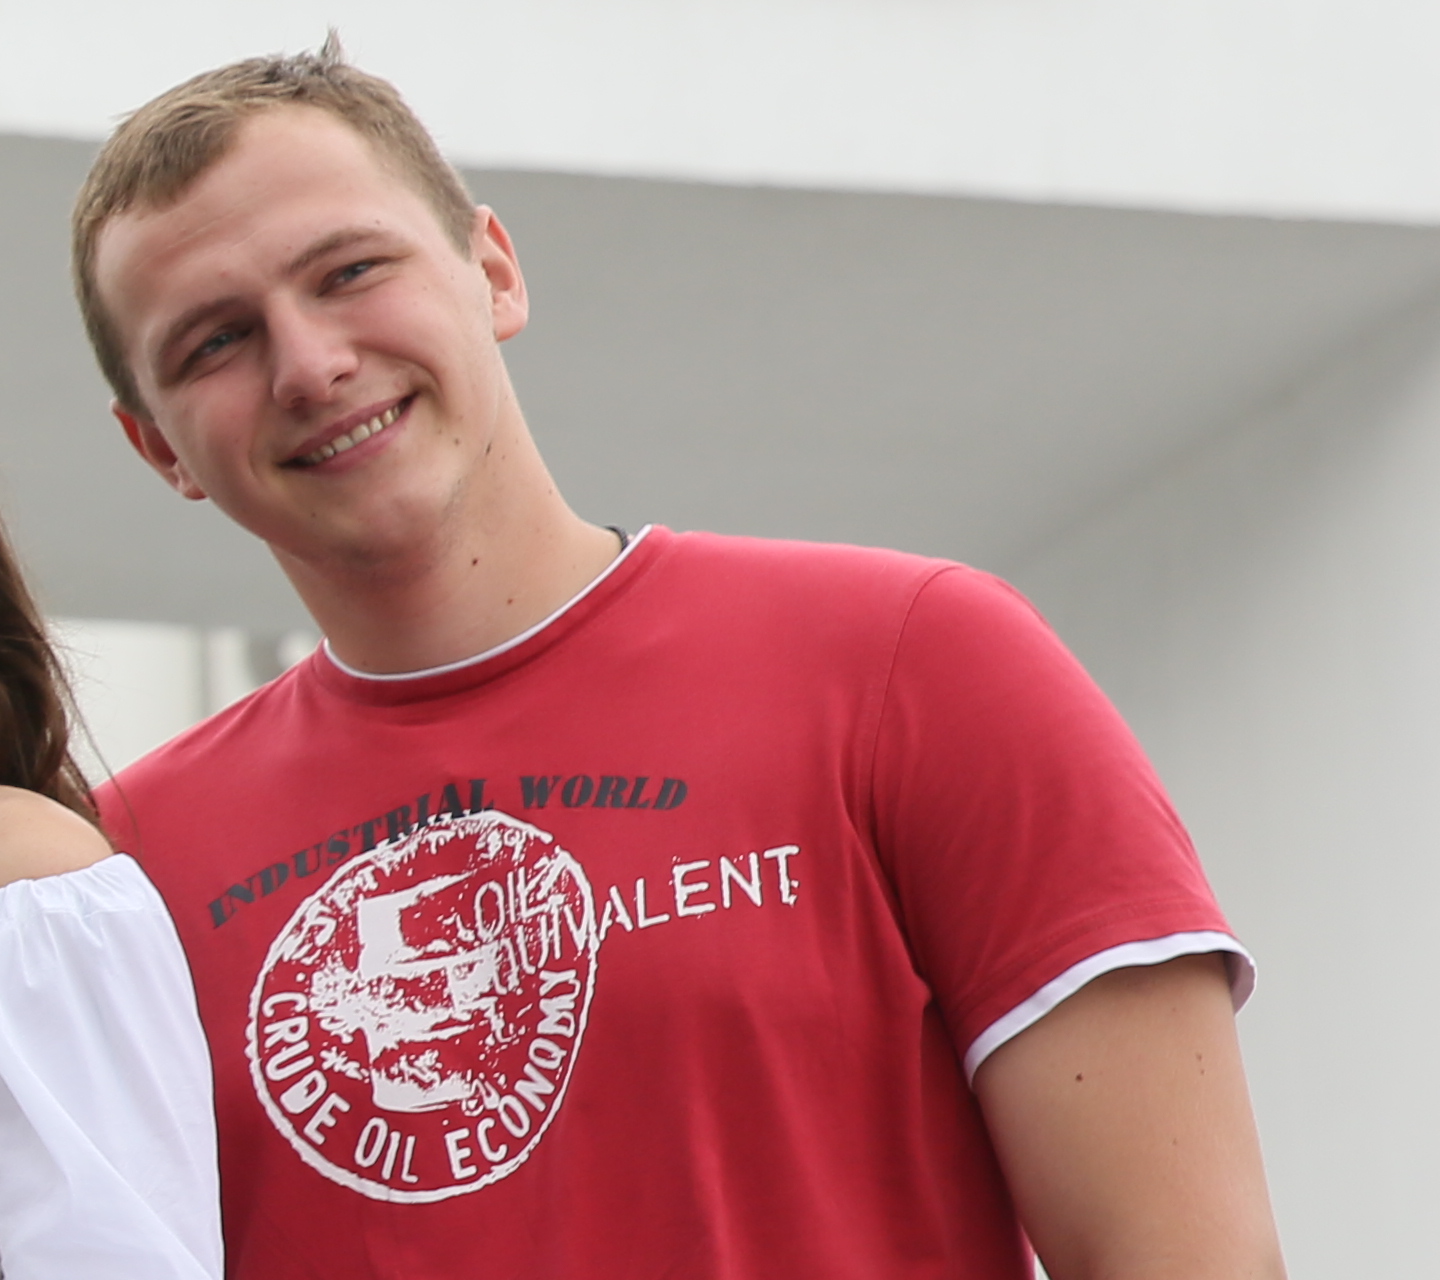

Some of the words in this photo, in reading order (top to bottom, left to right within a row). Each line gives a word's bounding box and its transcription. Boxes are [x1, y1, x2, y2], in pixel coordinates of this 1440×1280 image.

[206, 778, 495, 929] INDUSTRIAL
[519, 775, 688, 811] WORLD
[262, 991, 351, 1146] CRUDE
[354, 1116, 419, 1184] OIL
[444, 969, 581, 1181] ECONOMY
